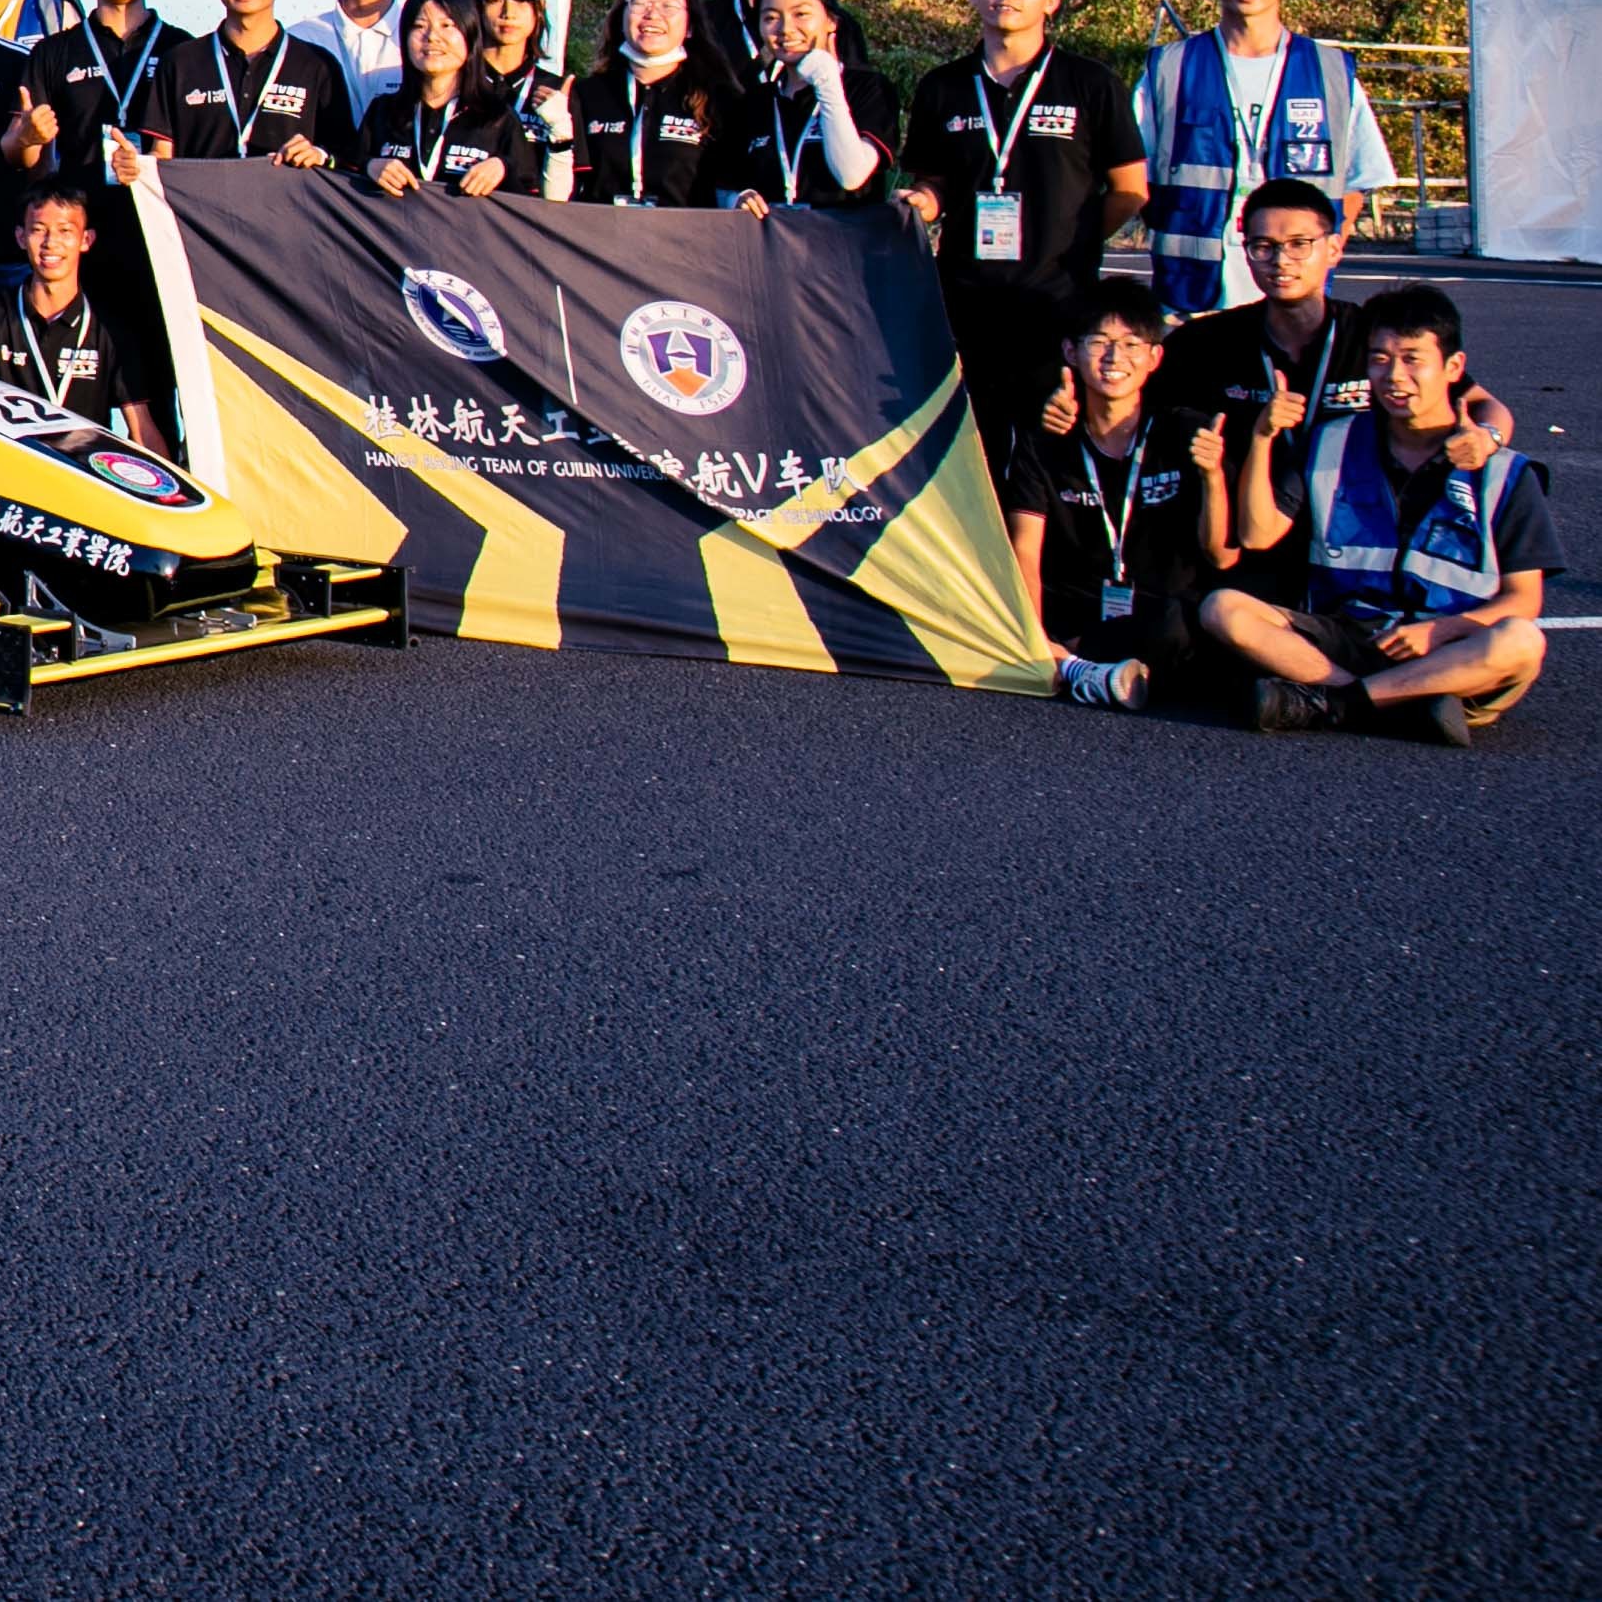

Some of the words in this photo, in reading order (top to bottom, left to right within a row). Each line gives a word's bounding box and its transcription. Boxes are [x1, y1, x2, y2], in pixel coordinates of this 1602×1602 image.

[1296, 122, 1319, 138] 22
[482, 457, 523, 476] TEAM
[528, 459, 548, 476] OF
[553, 461, 602, 479] GUILIN
[603, 461, 668, 481] UNIVERS
